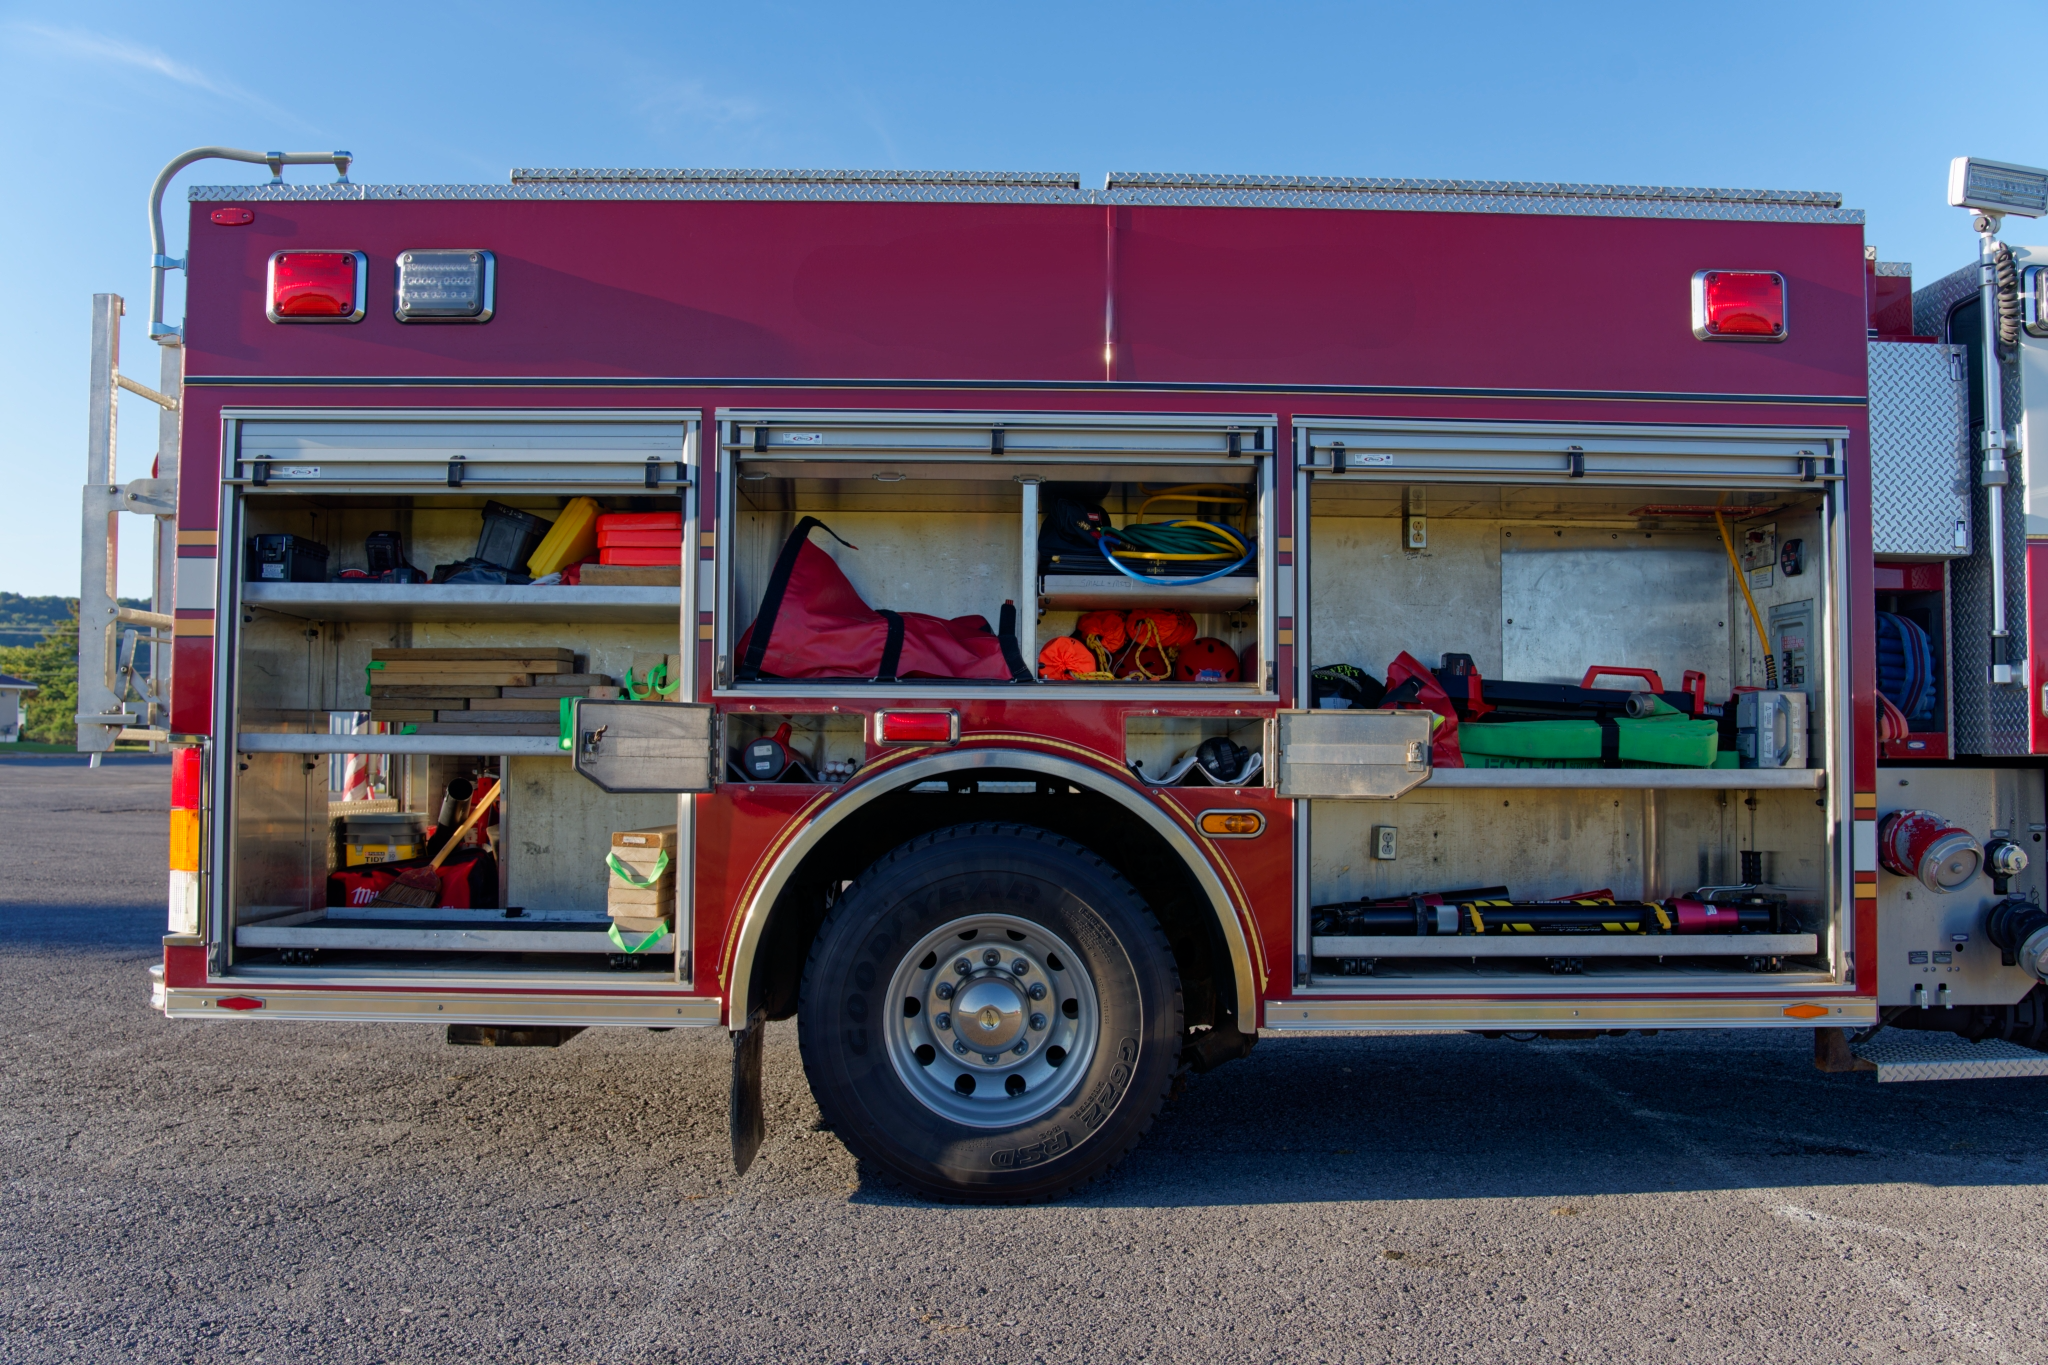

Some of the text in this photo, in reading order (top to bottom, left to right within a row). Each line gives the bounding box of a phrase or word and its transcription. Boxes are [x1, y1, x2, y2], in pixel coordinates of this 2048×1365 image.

[846, 878, 1041, 1057] GOODYEAR
[989, 1036, 1139, 1167] G622 RSD
